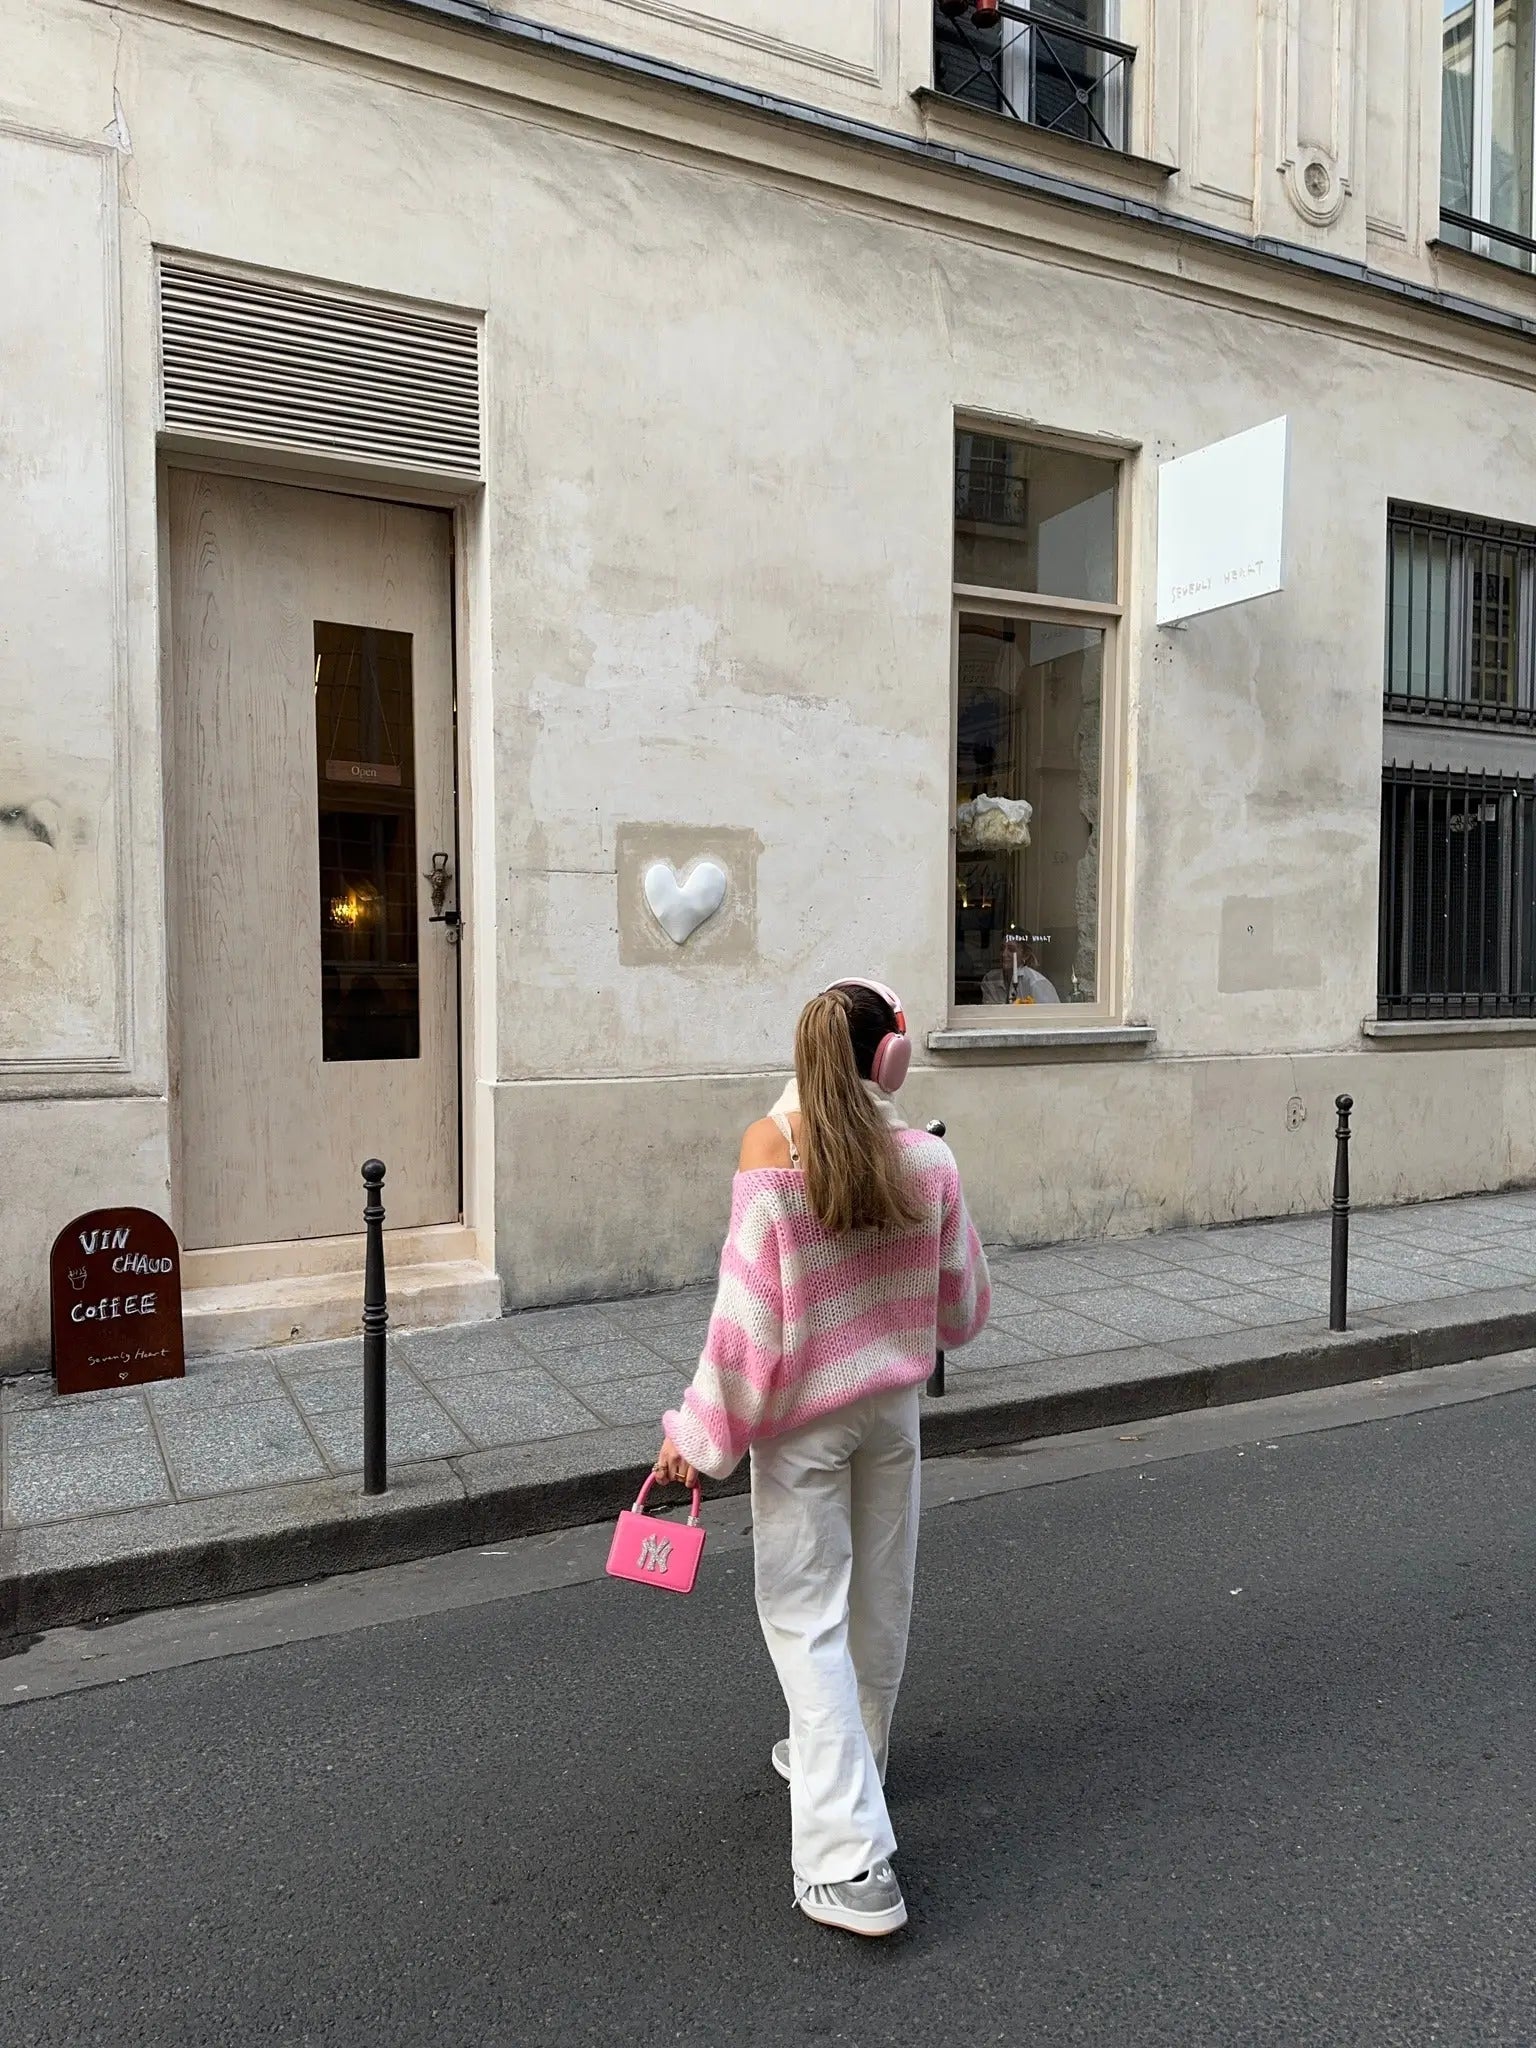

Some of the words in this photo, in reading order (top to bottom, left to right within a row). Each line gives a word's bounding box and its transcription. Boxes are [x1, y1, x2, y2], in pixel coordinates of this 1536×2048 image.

[351, 765, 377, 778] Open
[78, 1228, 130, 1255] VIN
[112, 1253, 173, 1275] CHAUD
[135, 1348, 170, 1360] Heart
[637, 1533, 674, 1574] NY
